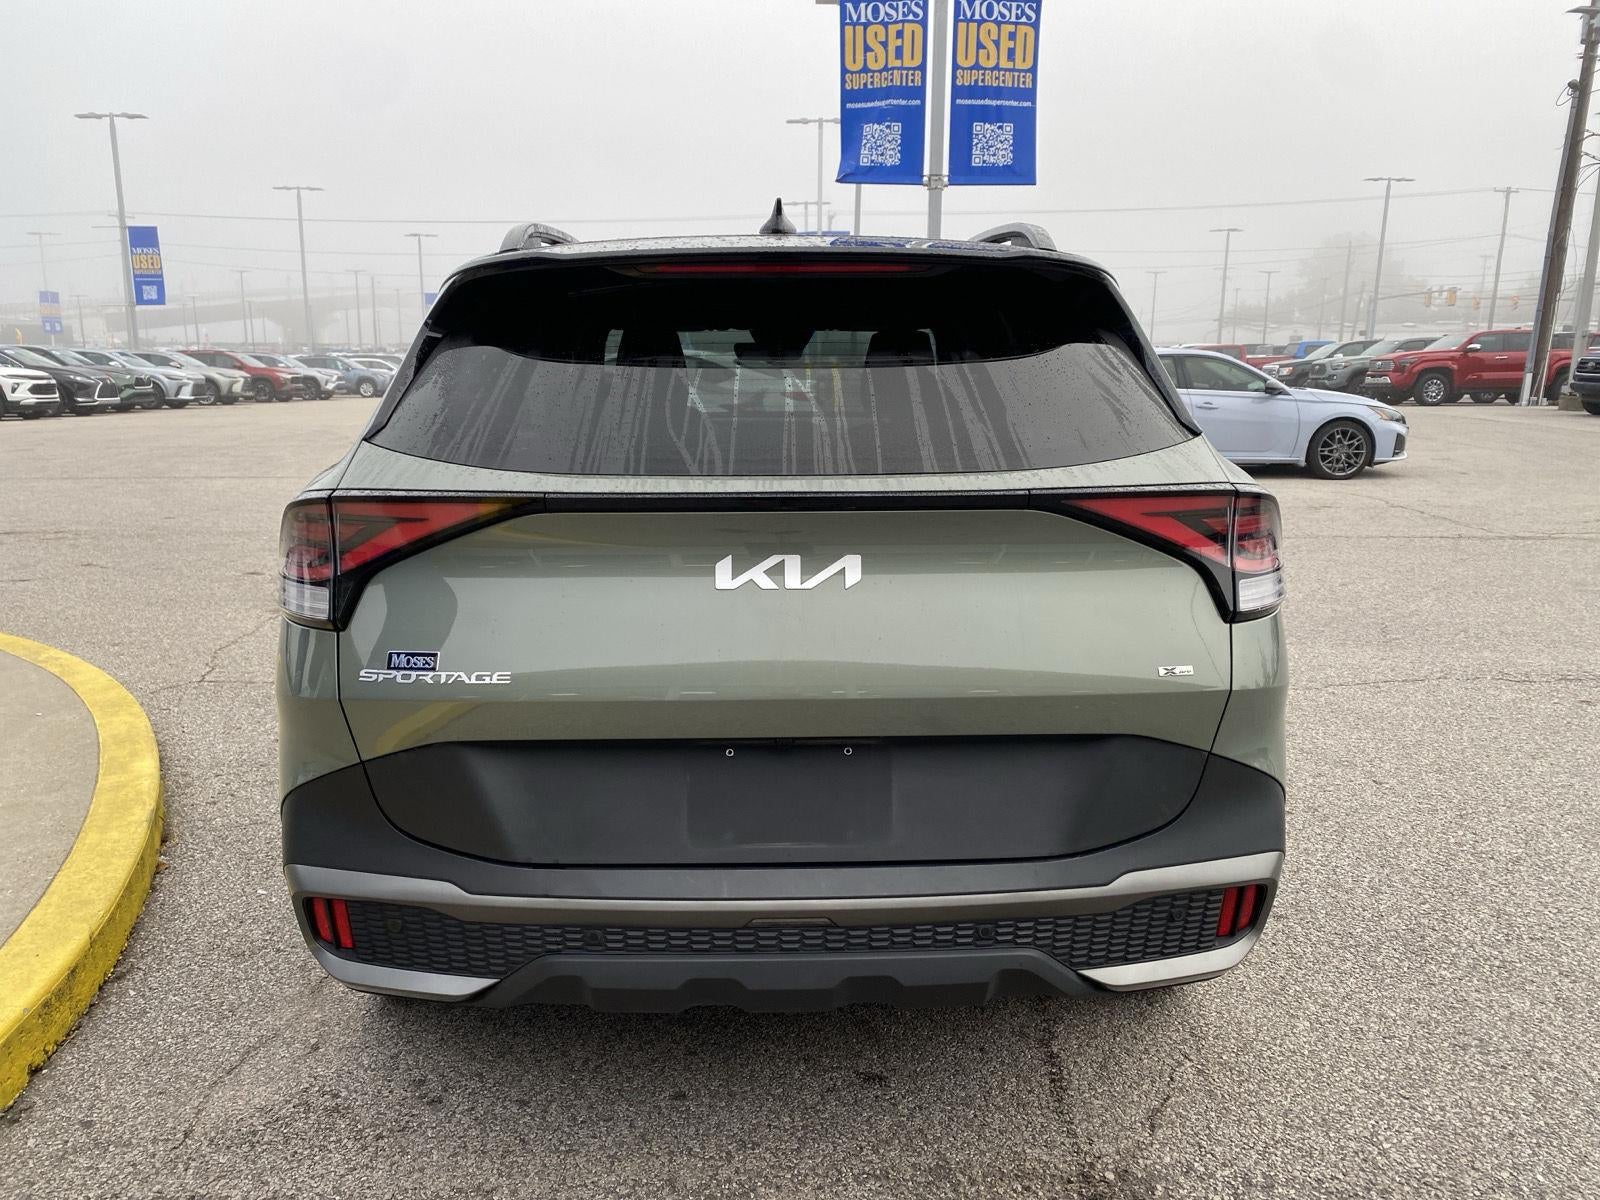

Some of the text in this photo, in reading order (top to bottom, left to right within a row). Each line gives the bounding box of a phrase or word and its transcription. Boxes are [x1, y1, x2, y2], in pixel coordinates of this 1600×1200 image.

[845, 0, 924, 23] MOSES
[959, 0, 1037, 23] MOSES
[844, 22, 923, 71] USED
[956, 22, 1035, 69] USED
[845, 70, 922, 90] SUPERCENTER
[956, 69, 1033, 88] SUPERCENTER
[846, 98, 921, 109] mosesusedsupercenter.com
[956, 98, 1032, 107] mosesusedsupercenter.com
[132, 255, 161, 269] USED
[715, 555, 862, 590] KIA
[358, 669, 512, 684] SPORTAGE
